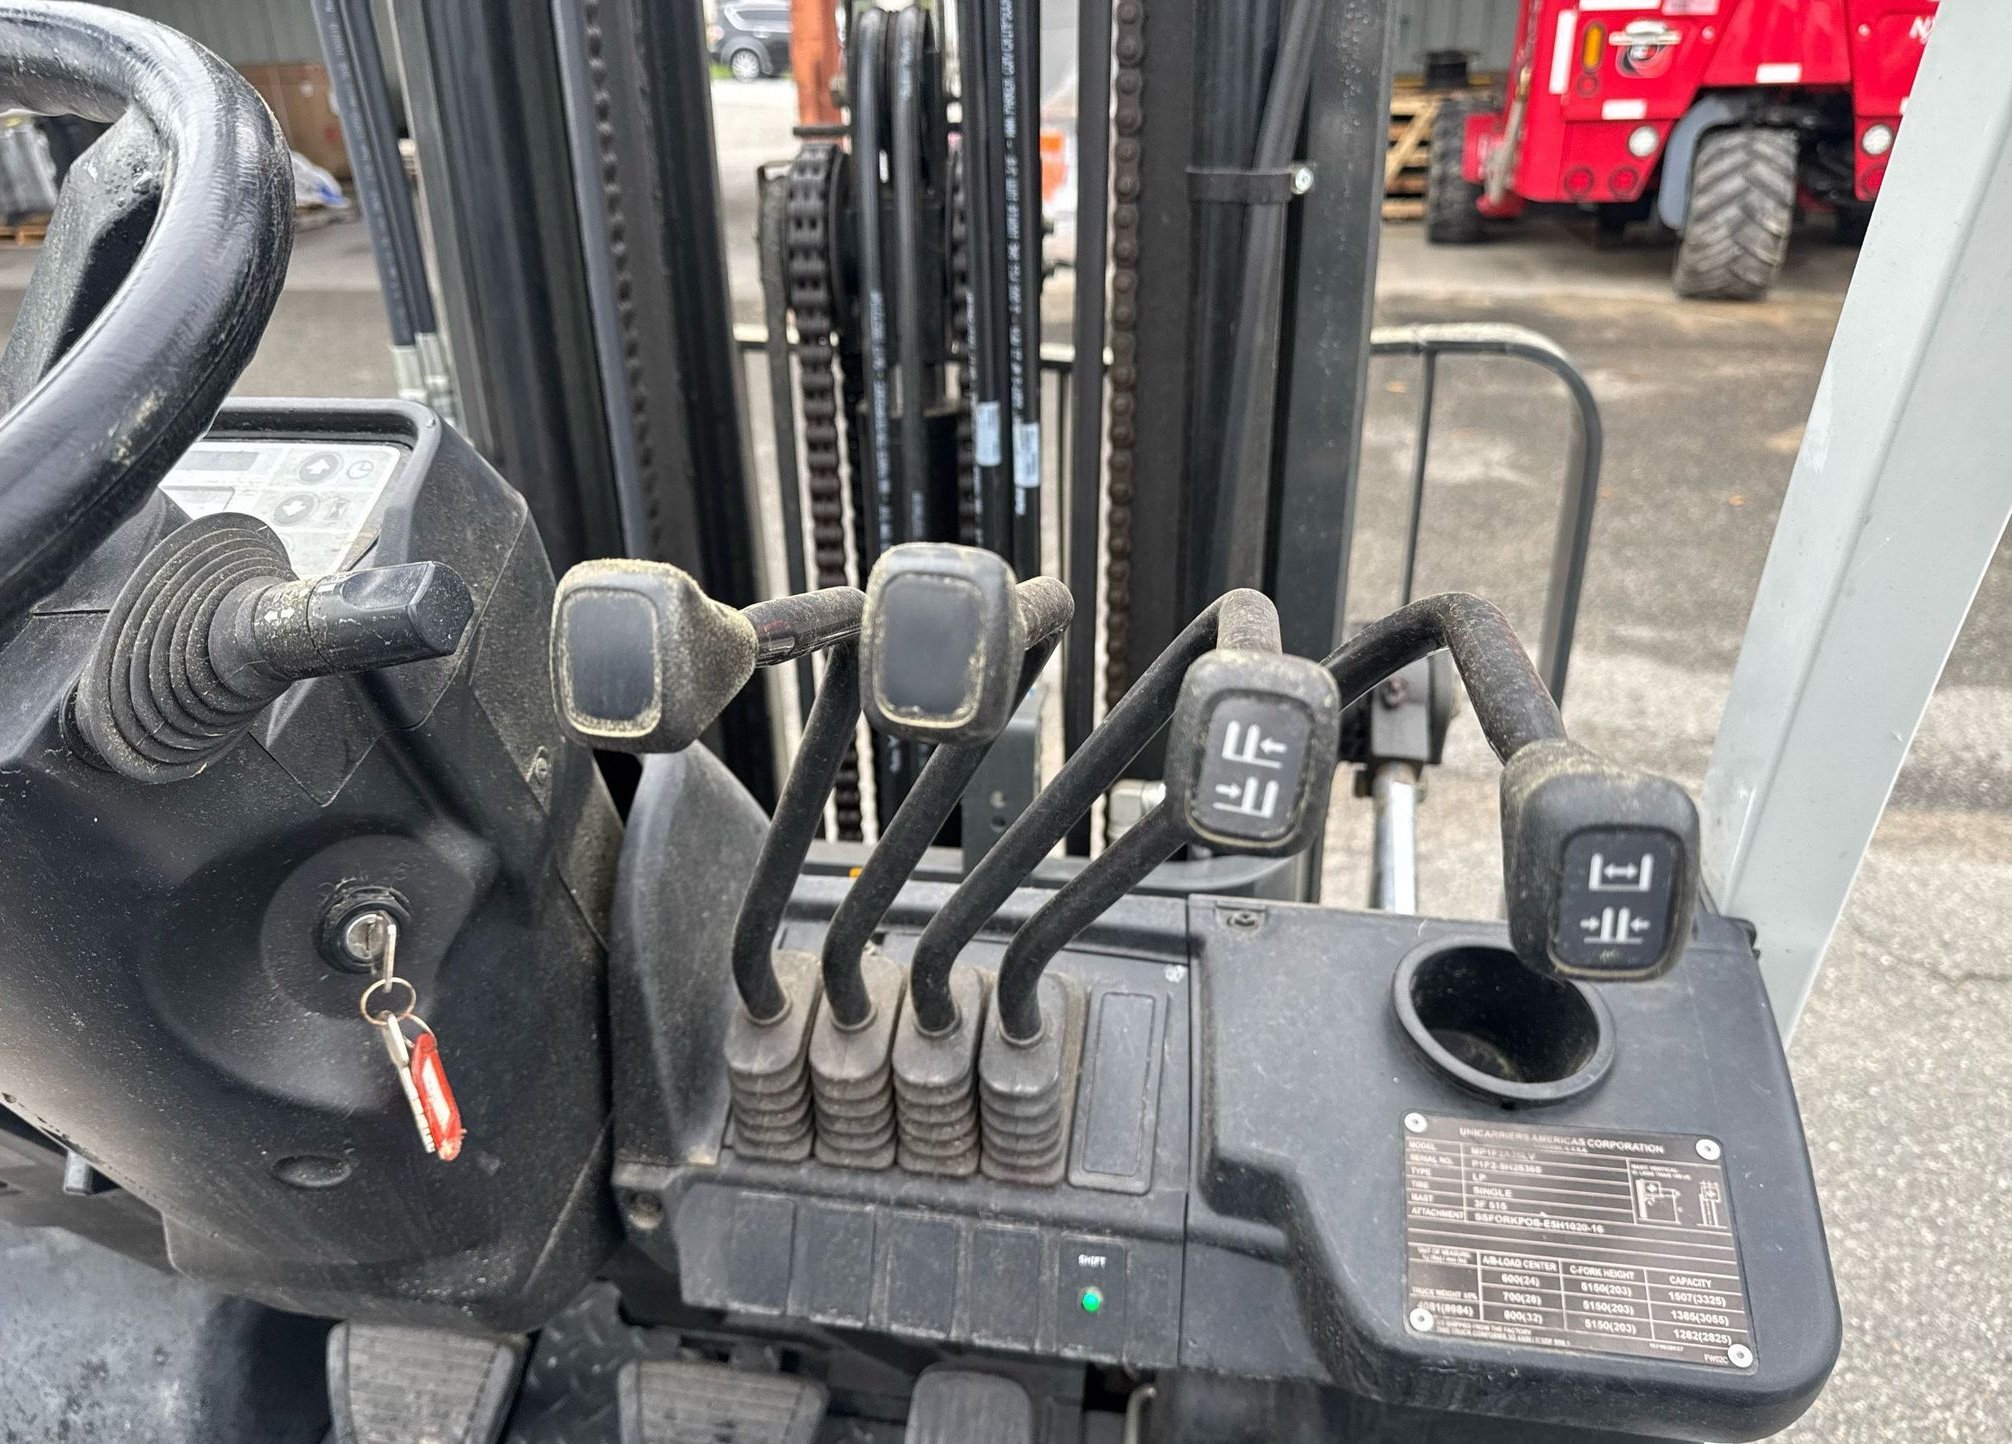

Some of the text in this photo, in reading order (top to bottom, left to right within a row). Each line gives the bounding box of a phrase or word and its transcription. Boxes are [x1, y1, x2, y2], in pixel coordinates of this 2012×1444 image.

[1531, 1134, 1586, 1147] AMERICAS
[1586, 1138, 1664, 1154] CORPORATION
[1411, 1167, 1430, 1176] TYPE
[1472, 1173, 1486, 1182] LP
[1473, 1186, 1512, 1197] SINGLE
[1411, 1193, 1433, 1203] MAST
[1411, 1206, 1463, 1218] ATTACHMENT
[1078, 1254, 1107, 1268] SHIFT
[1523, 1260, 1557, 1271] CENTER
[1569, 1264, 1636, 1280] C-FORK HEIGHT
[1669, 1275, 1713, 1288] CAPACITY
[1668, 1291, 1727, 1307] 1507(3325)
